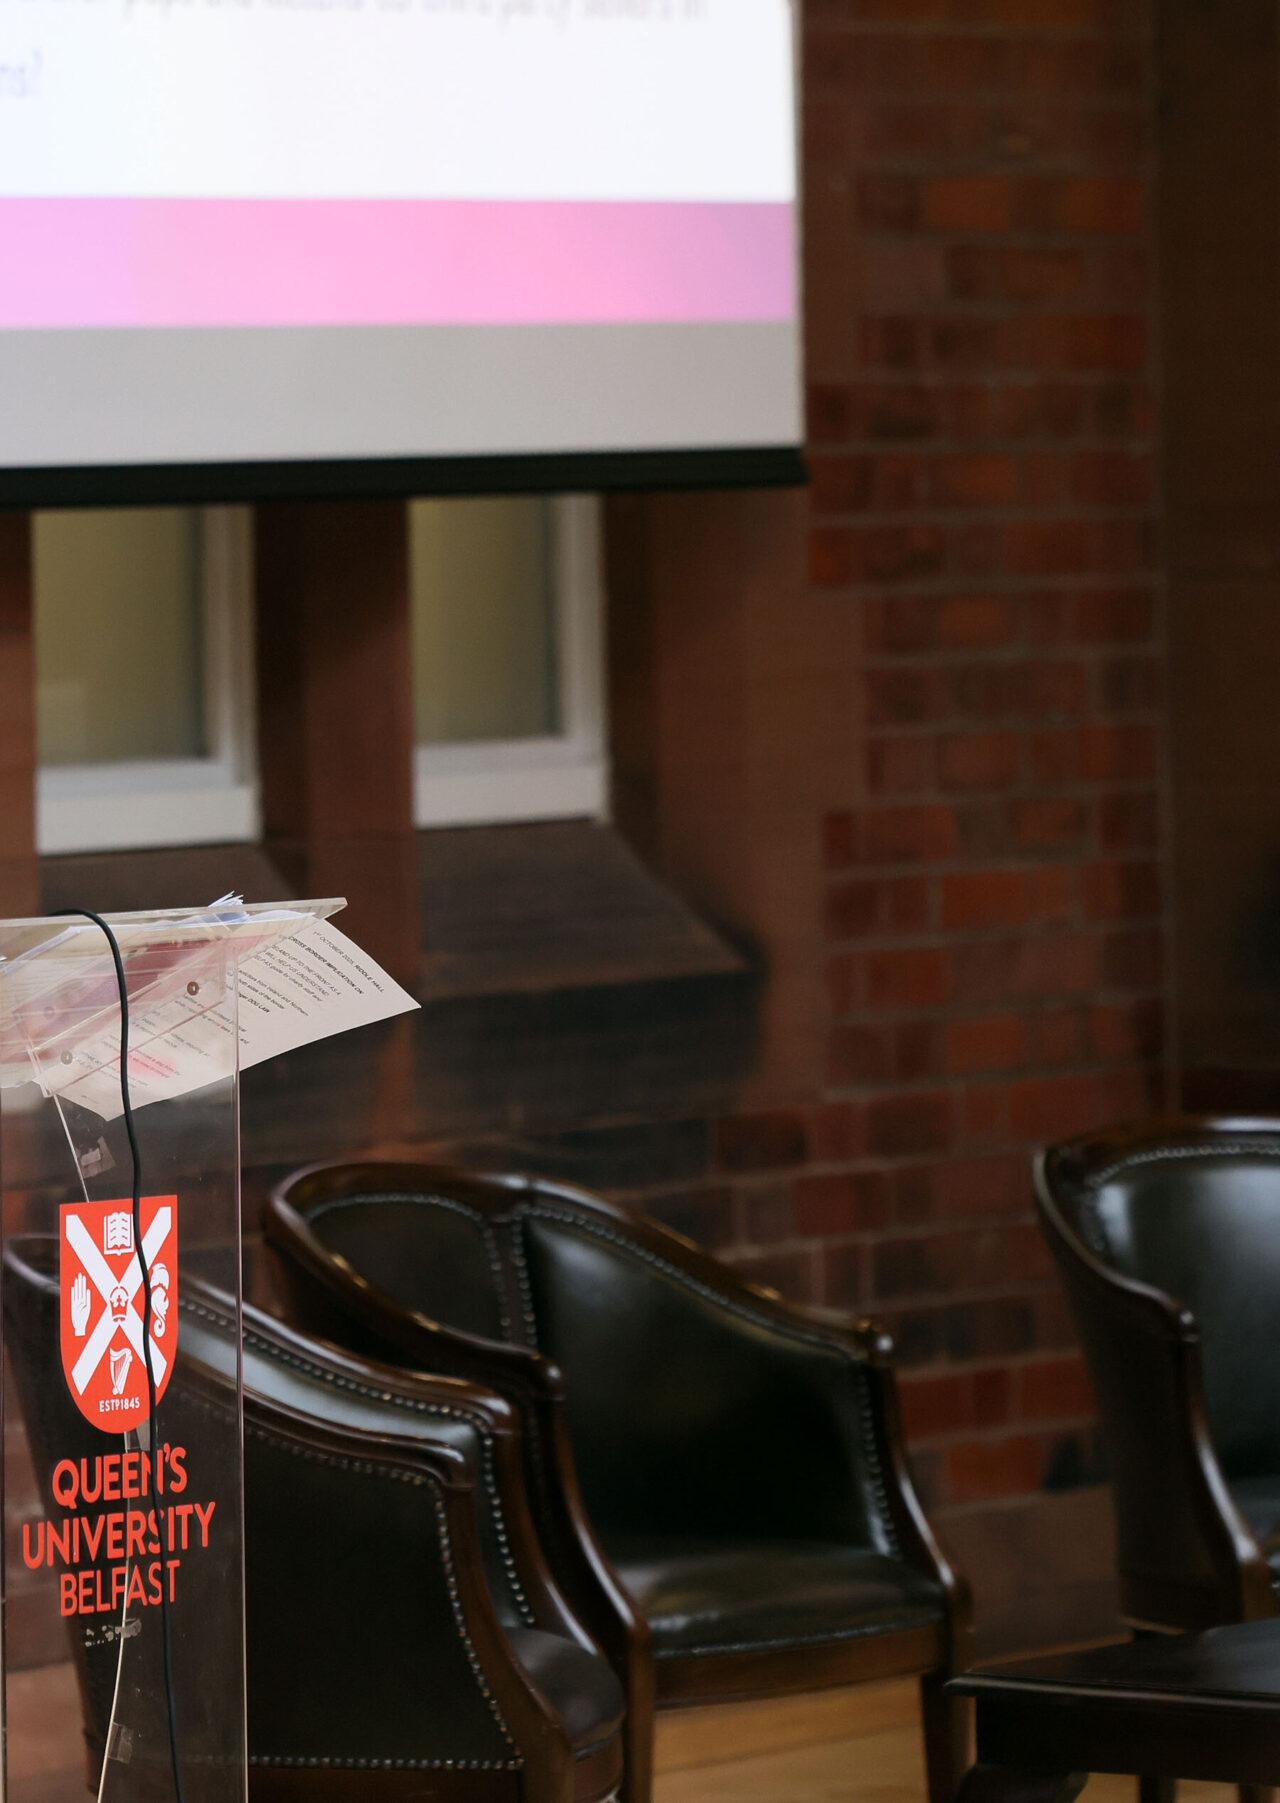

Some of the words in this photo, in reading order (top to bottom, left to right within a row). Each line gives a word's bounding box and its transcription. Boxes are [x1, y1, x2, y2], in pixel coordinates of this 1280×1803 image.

[305, 946, 327, 963] BORDER
[52, 1442, 188, 1510] QUEEN'S
[22, 1501, 216, 1570] UNIVERSITY
[60, 1559, 181, 1617] BELFAST
